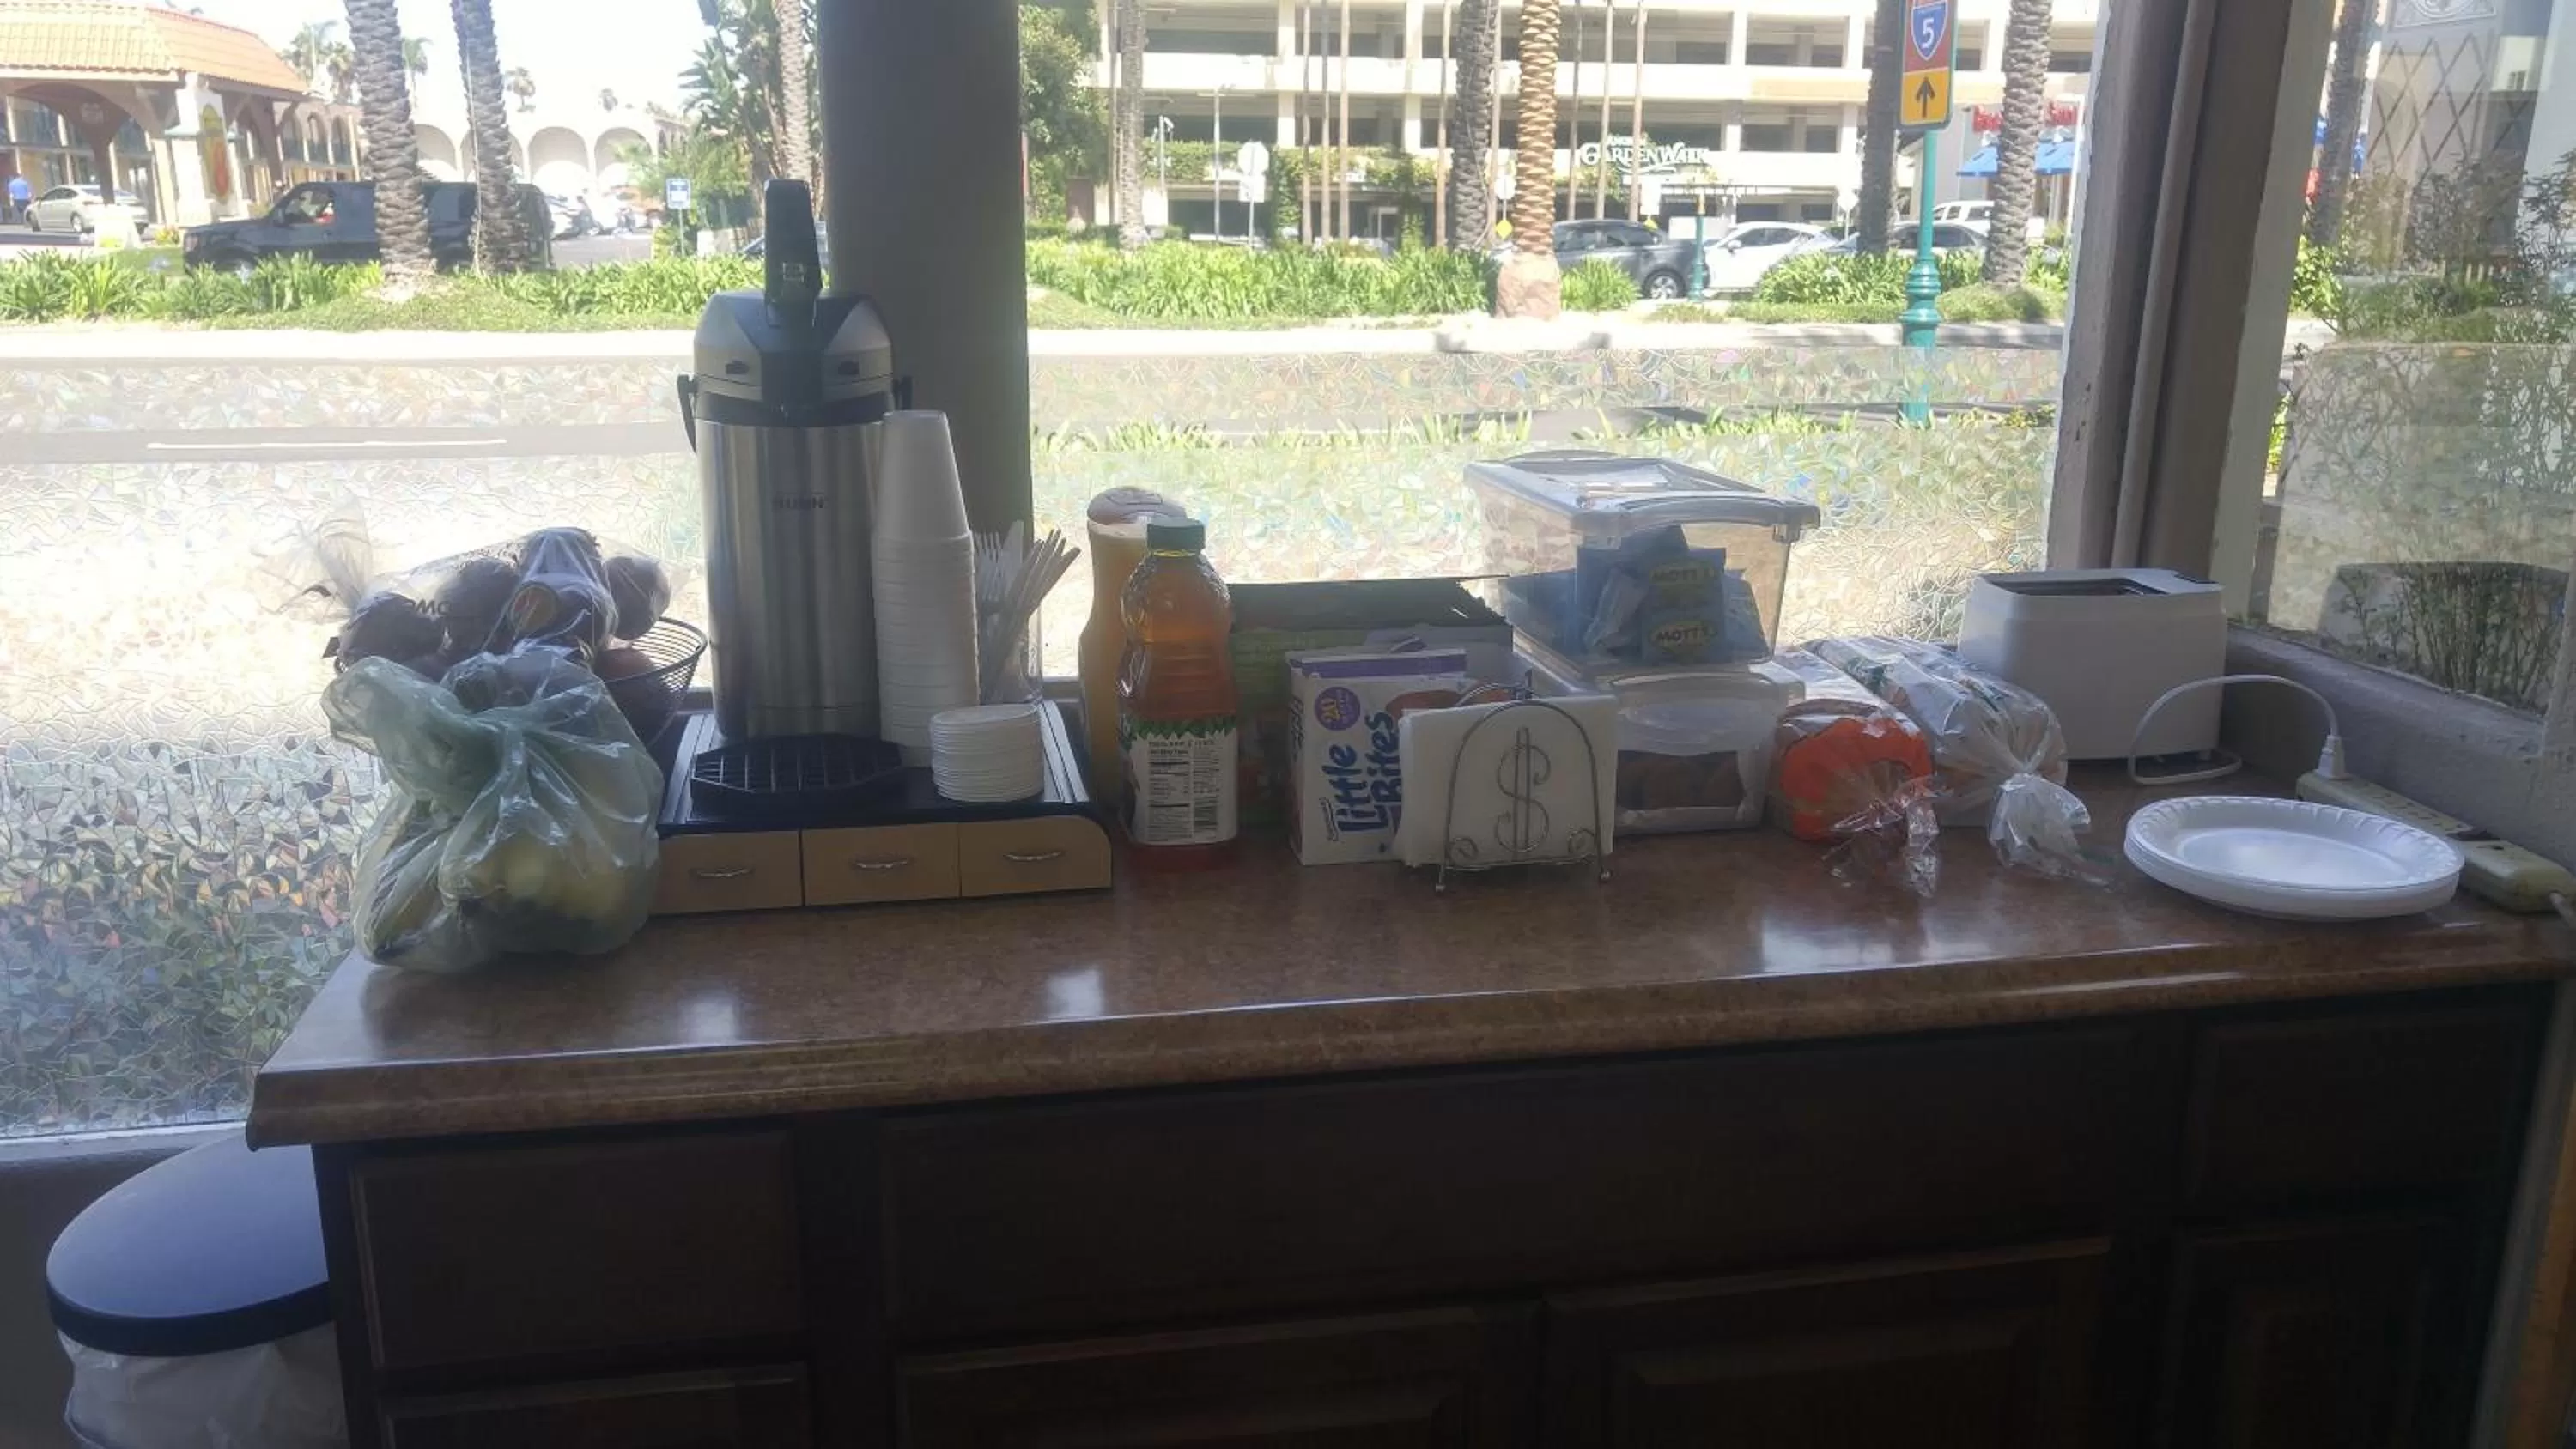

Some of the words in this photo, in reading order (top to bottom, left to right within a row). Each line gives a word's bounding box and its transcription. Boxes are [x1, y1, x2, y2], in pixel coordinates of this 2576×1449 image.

[1921, 17, 1935, 49] 5
[1321, 744, 1388, 832] Little
[1364, 712, 1402, 802] Bites
